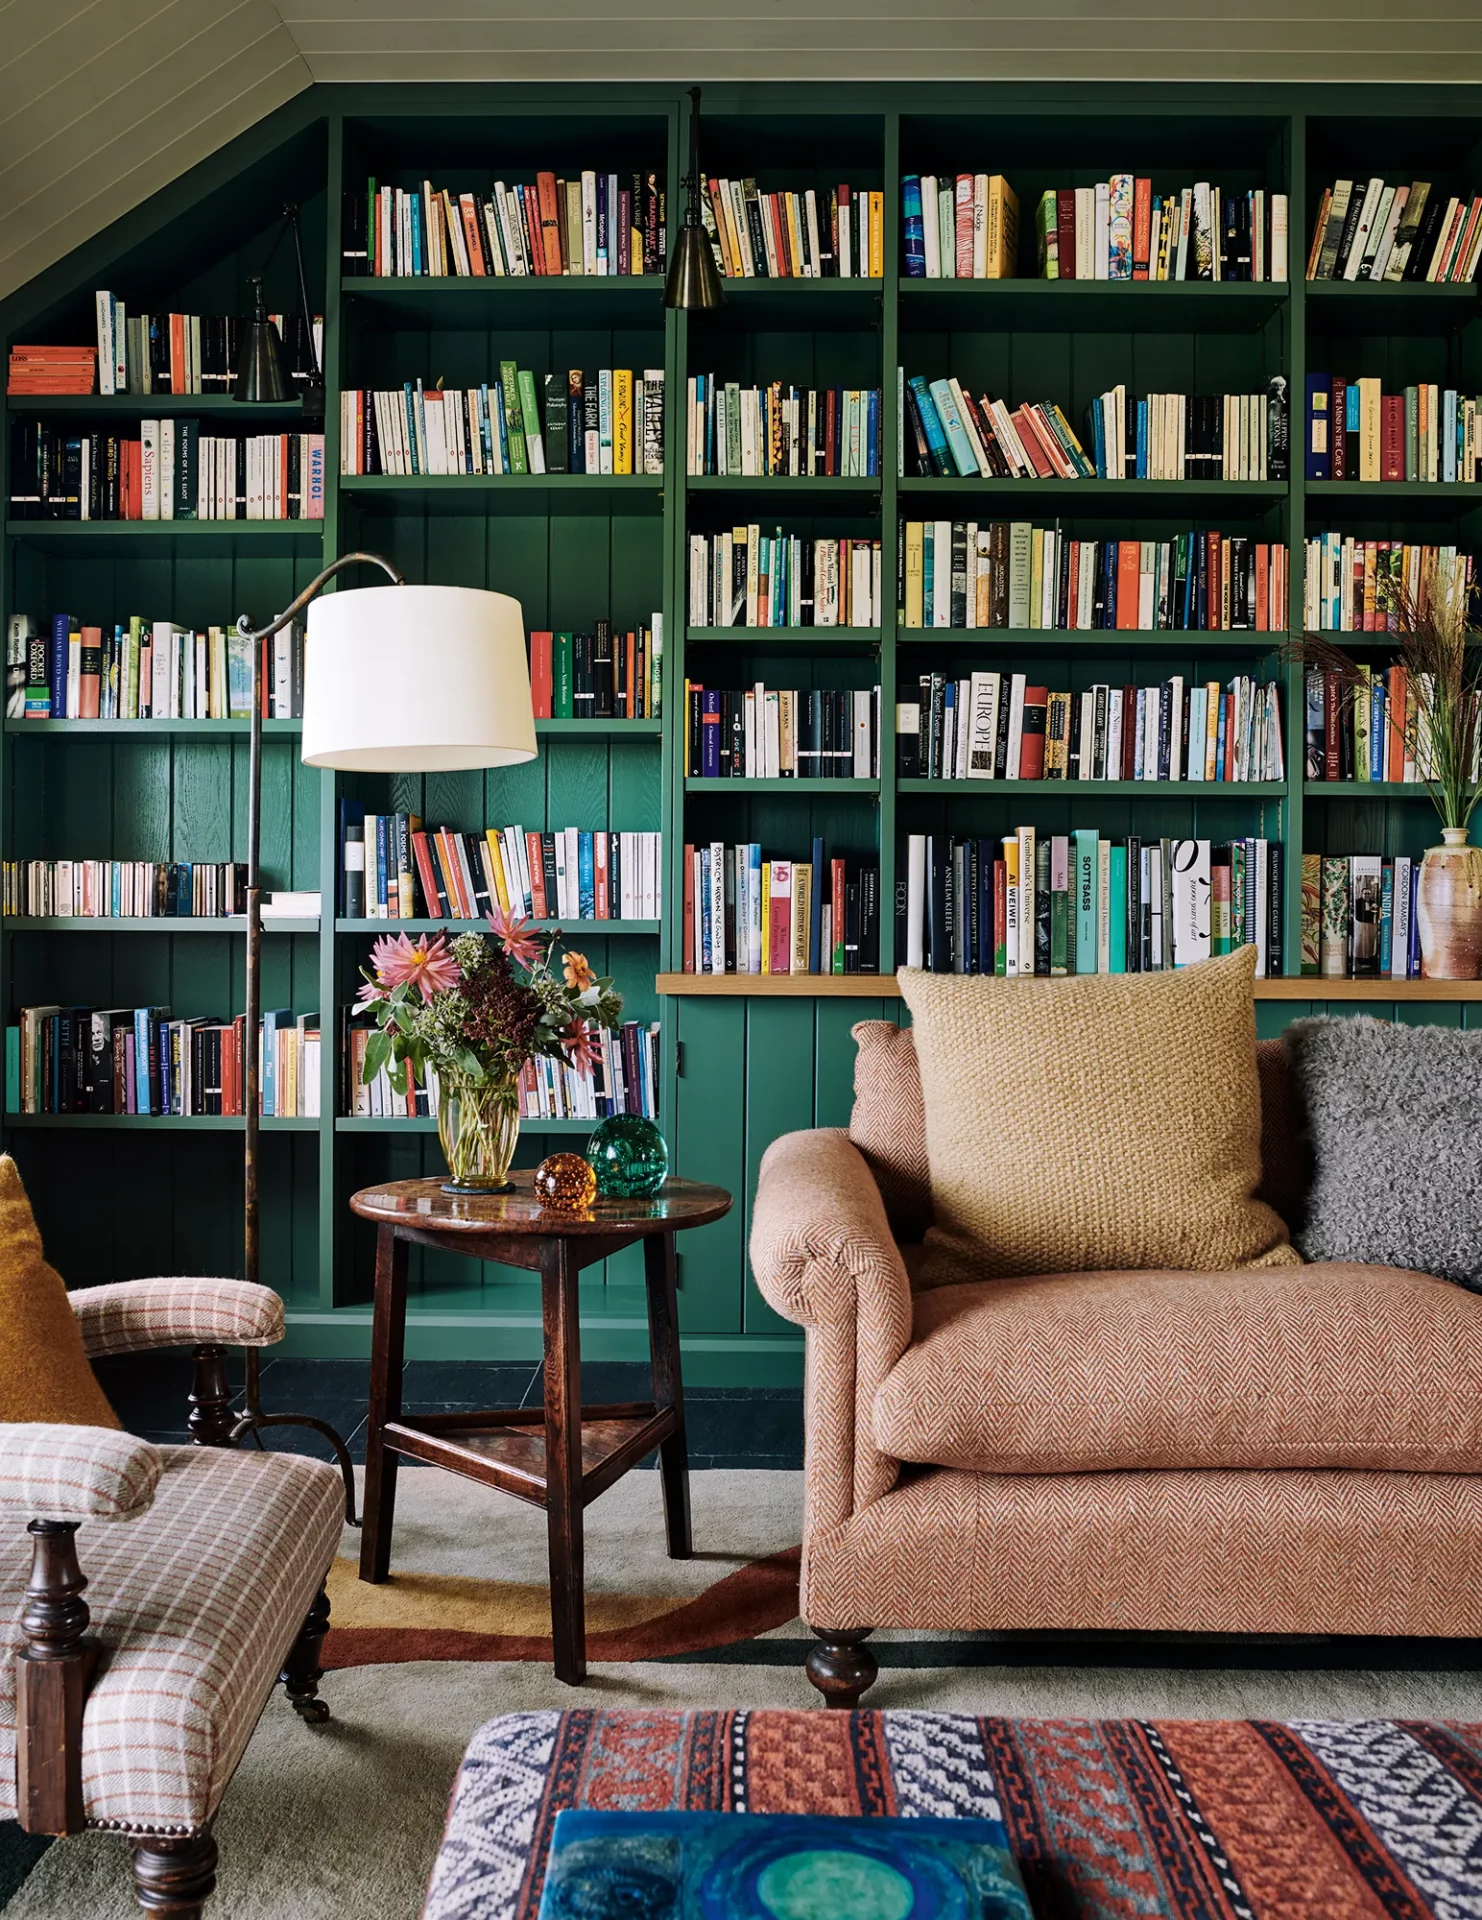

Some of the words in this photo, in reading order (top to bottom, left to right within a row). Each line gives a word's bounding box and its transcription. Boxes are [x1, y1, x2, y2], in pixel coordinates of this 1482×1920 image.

[975, 209, 983, 231] Nudge
[585, 385, 596, 401] THE
[1335, 391, 1343, 405] THE
[585, 403, 597, 427] FARM
[645, 393, 663, 444] VALLEY
[1335, 406, 1343, 425] MIND
[1273, 416, 1281, 447] STONES
[1335, 433, 1343, 447] THE
[182, 460, 188, 468] OF
[1335, 449, 1343, 466] CAVE
[142, 451, 155, 495] Sapiens
[312, 449, 322, 500] WARHOL
[933, 692, 943, 711] Rupert
[934, 713, 942, 737] Everett
[974, 683, 993, 749] EUROPE
[944, 866, 953, 898] ANSELM
[1008, 874, 1016, 885] AI
[1056, 872, 1064, 889] Mark
[1083, 856, 1091, 911] SOTTSASS
[895, 882, 907, 915] RODIN
[1008, 888, 1016, 928] WEIWEI
[1024, 887, 1032, 924] Universe
[1056, 892, 1064, 915] Rothko
[1381, 892, 1392, 919] INDIA
[944, 902, 953, 932] KIEFER
[61, 1019, 69, 1046] KITH
